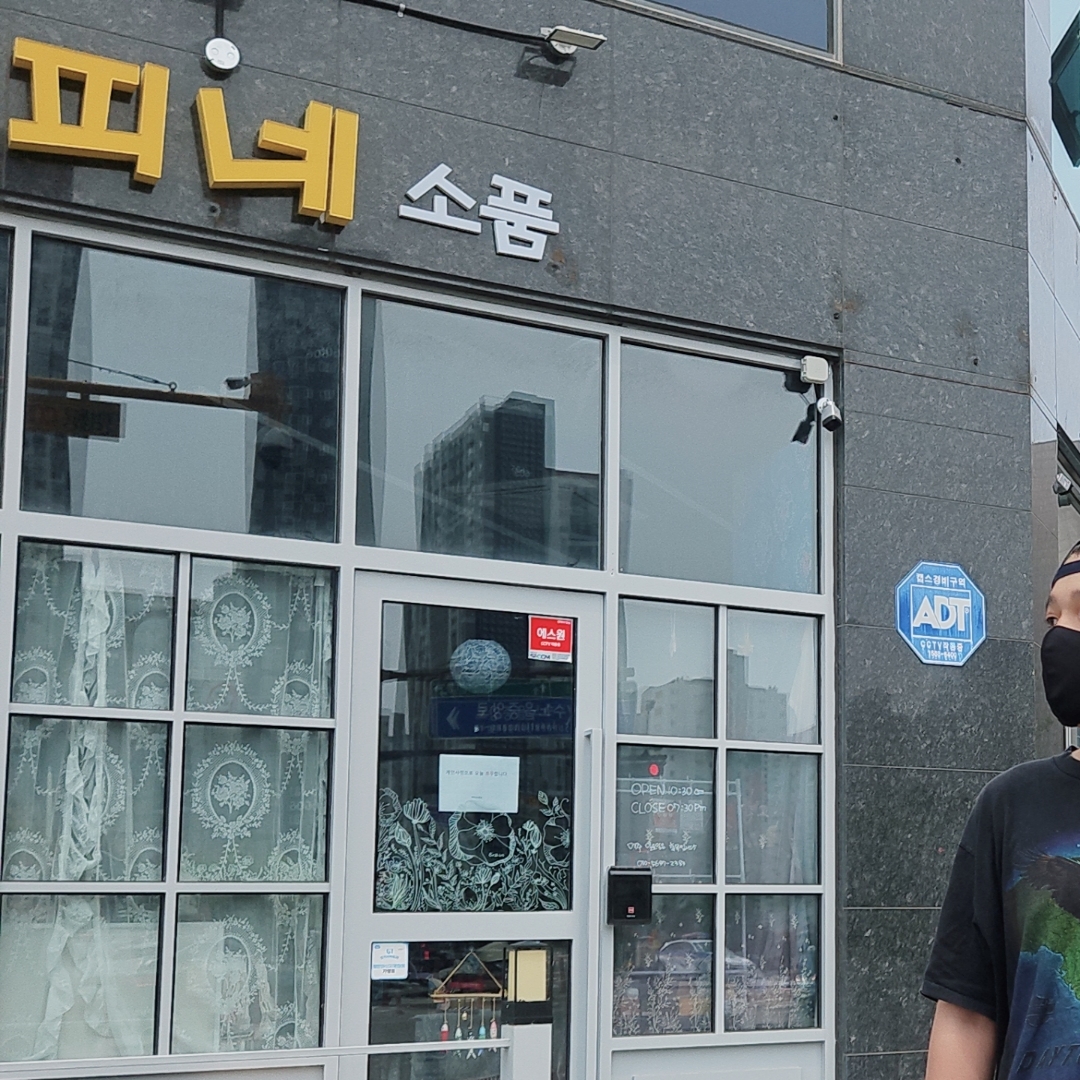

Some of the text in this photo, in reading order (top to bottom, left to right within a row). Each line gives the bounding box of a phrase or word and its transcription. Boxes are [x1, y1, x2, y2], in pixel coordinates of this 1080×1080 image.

[398, 163, 560, 261] 소품
[912, 594, 971, 632] ADT
[536, 627, 566, 641] 에스원
[630, 782, 666, 796] OPEN
[630, 801, 666, 814] CLOSE
[666, 803, 694, 812] 07:30
